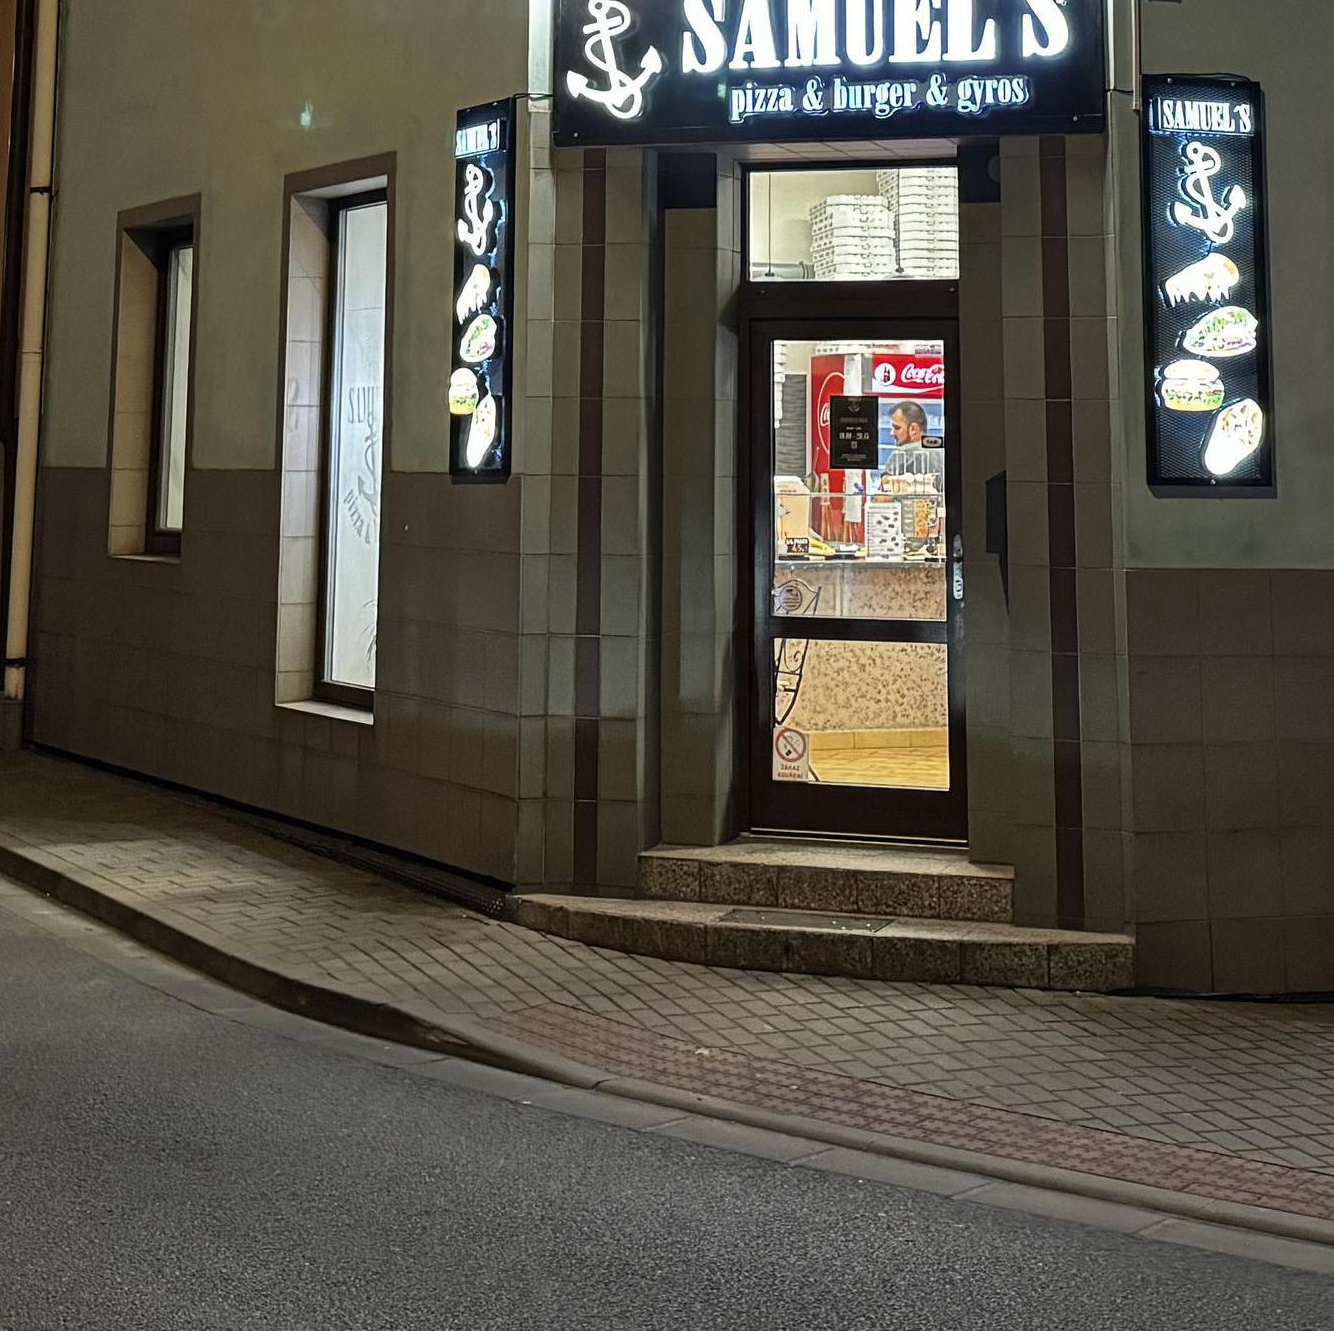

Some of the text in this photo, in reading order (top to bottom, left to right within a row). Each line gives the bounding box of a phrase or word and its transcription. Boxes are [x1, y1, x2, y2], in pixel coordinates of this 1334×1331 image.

[730, 73, 1028, 123] pizza & burger & gyros
